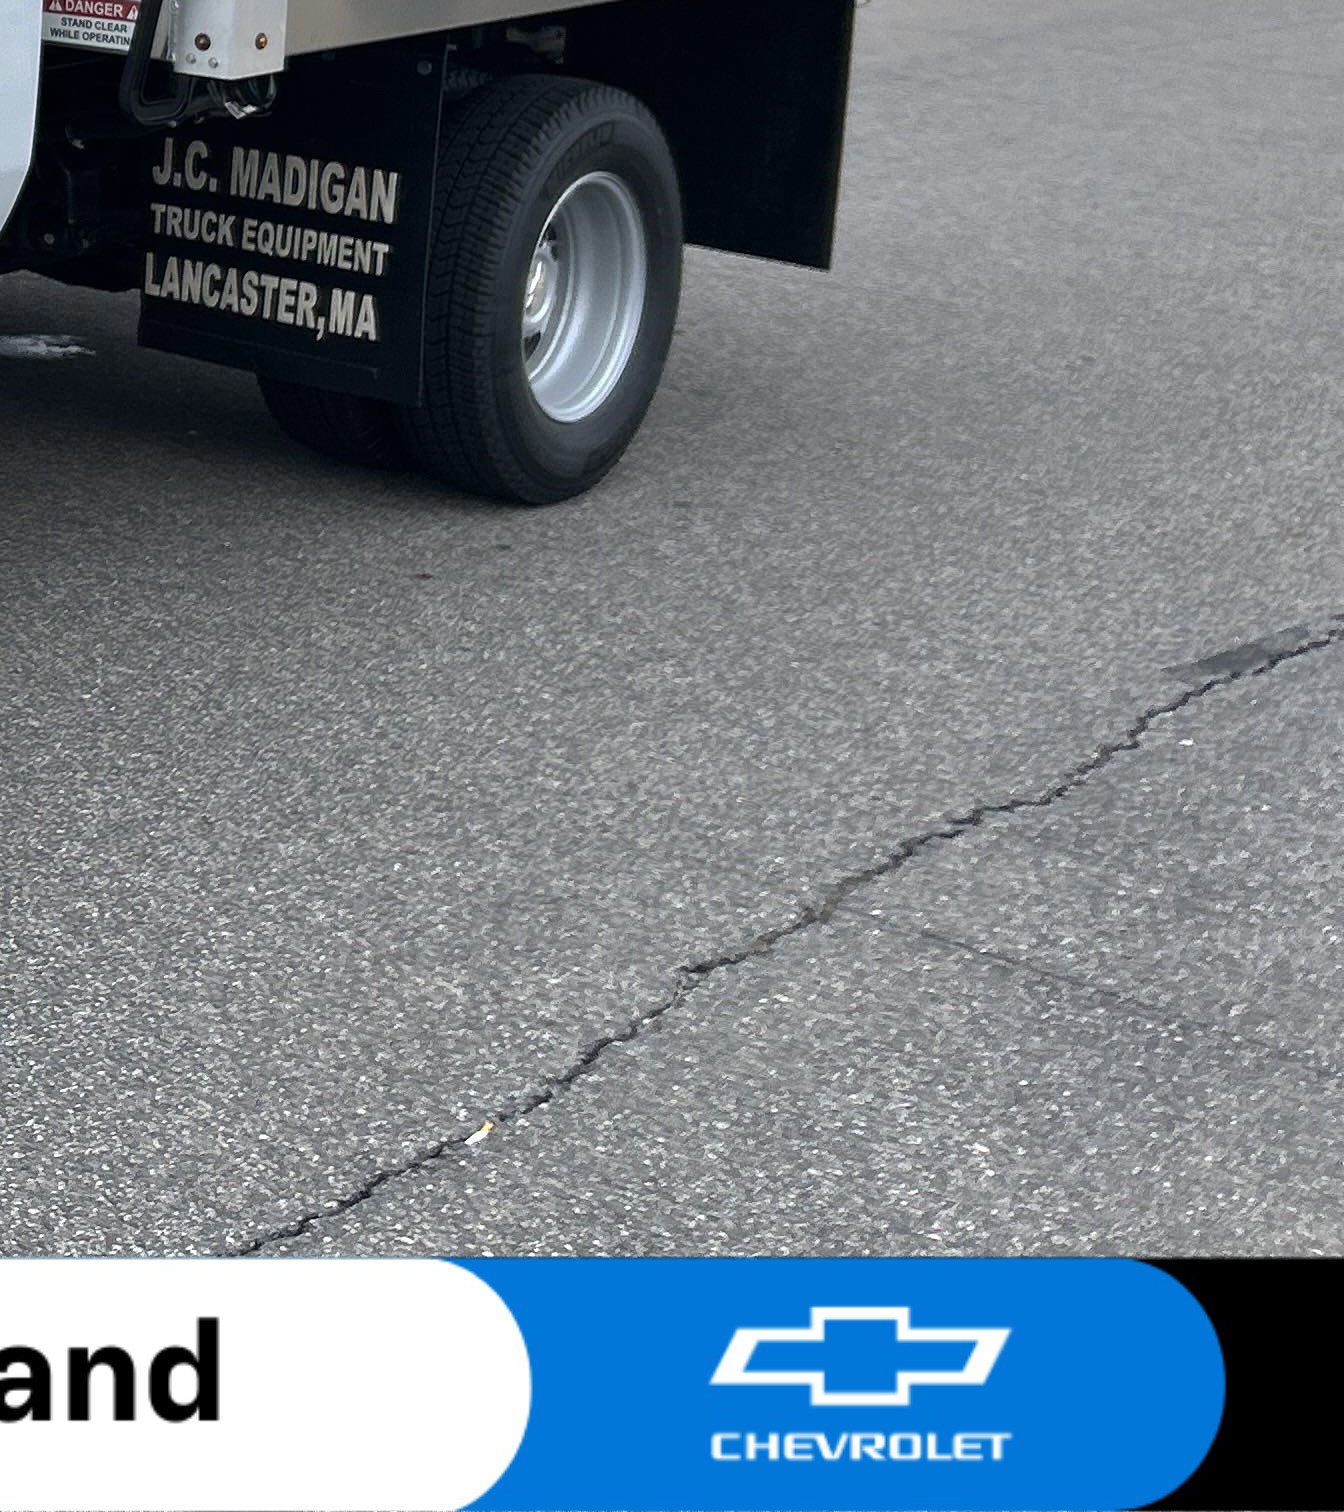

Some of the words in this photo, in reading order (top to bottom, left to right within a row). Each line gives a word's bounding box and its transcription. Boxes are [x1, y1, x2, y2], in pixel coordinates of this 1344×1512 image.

[49, 26, 80, 40] WHILE
[81, 30, 131, 46] OPERATIN
[61, 16, 93, 30] STAND
[94, 20, 128, 34] CLEAR
[151, 137, 218, 193] J.C.
[229, 145, 400, 225] MADIGAN
[150, 203, 237, 247] TRUCK
[241, 218, 391, 277] EQUIPMENT
